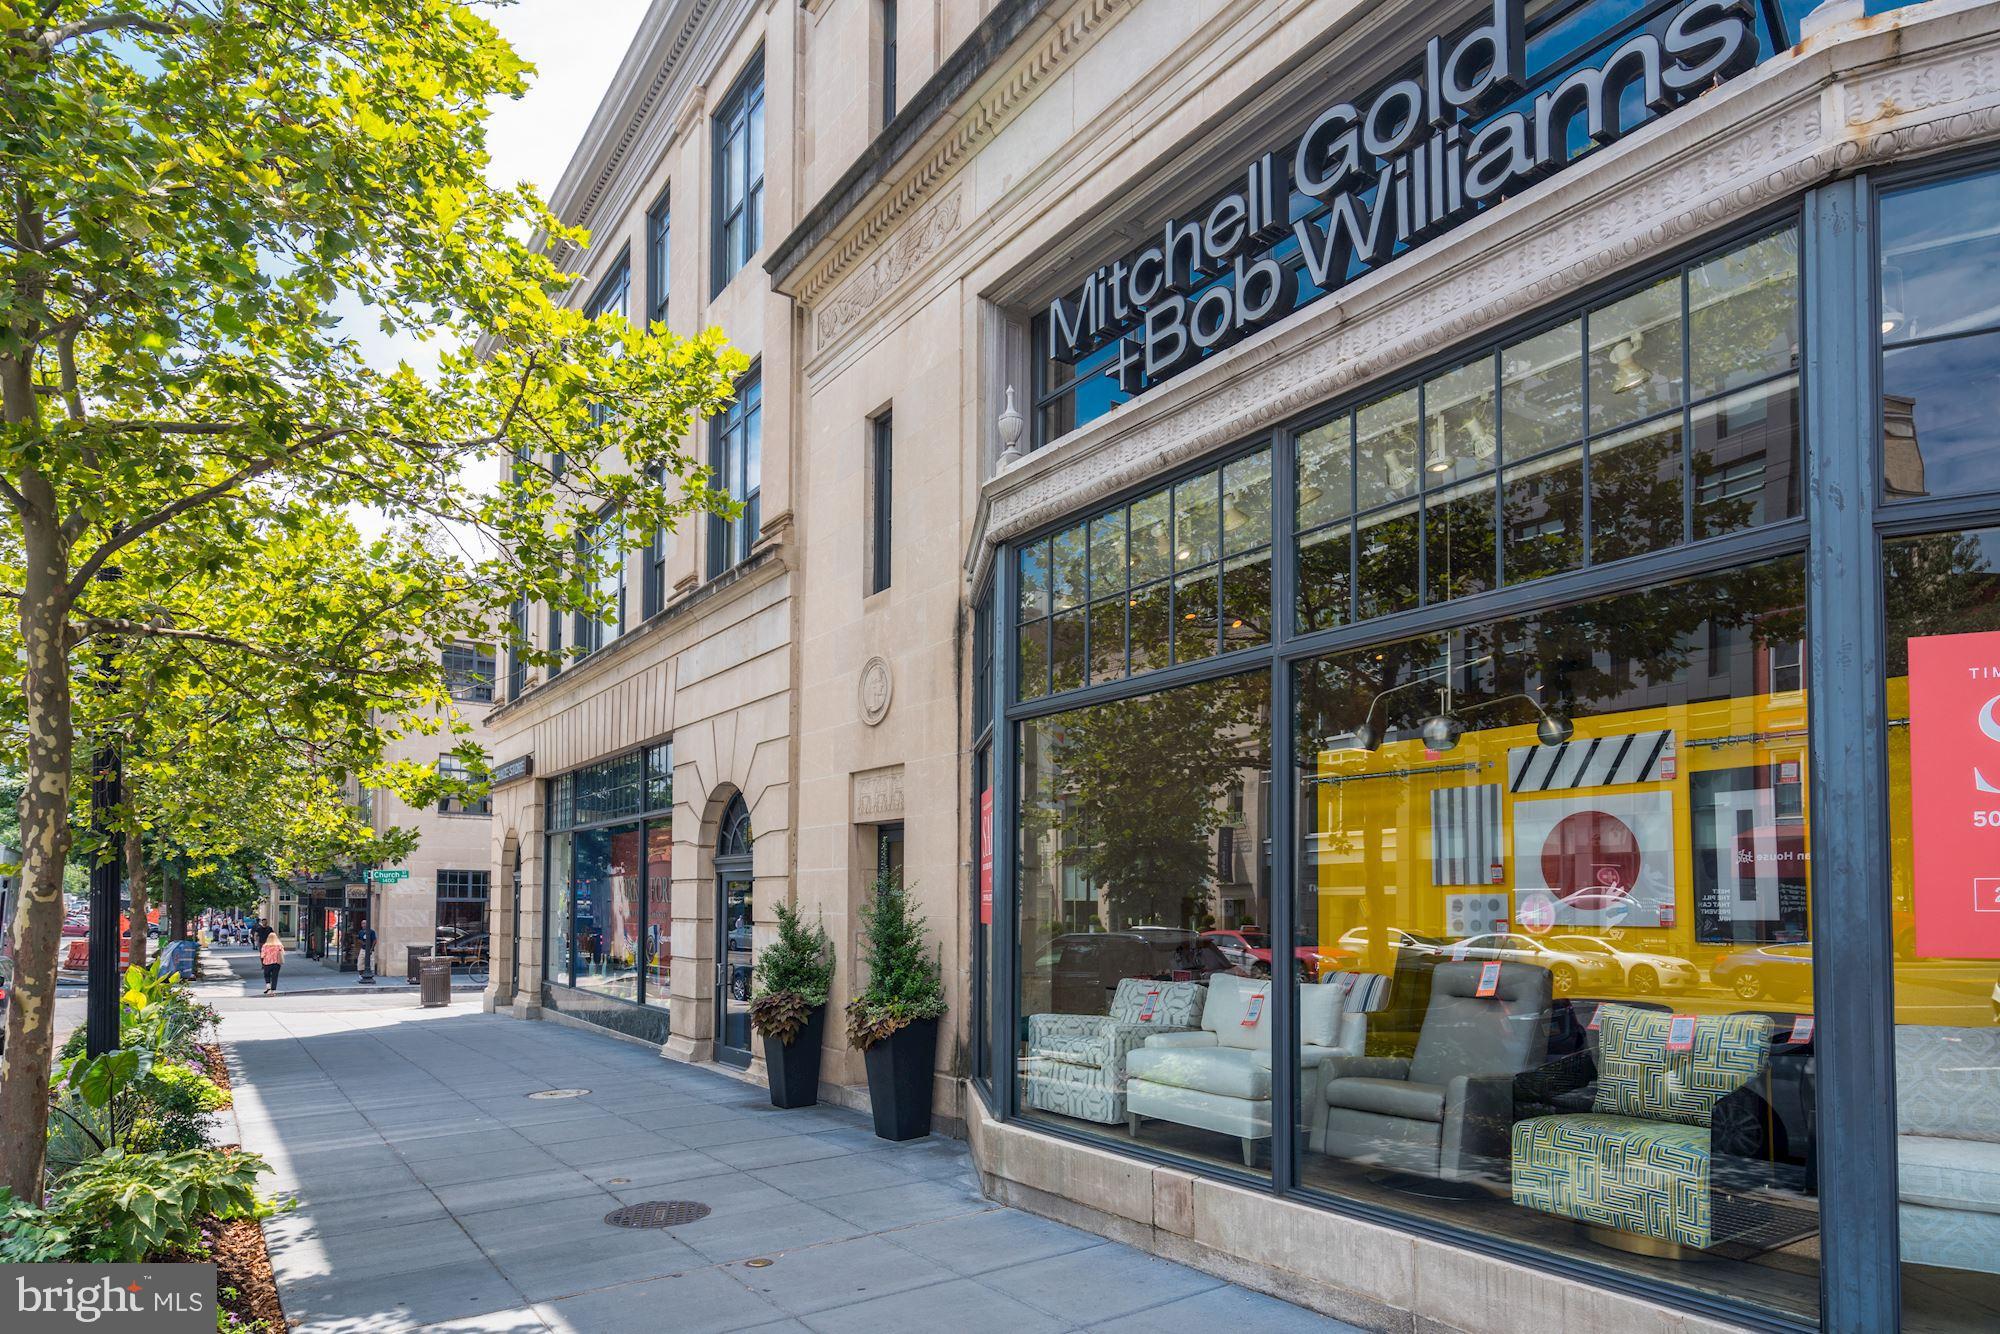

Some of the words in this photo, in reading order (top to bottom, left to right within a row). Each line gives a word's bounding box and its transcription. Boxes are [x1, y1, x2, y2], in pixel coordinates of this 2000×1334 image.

[1050, 152, 1277, 360] Mitchell
[1294, 0, 1510, 197] Gold
[1105, 254, 1283, 391] +Bob
[1293, 0, 1748, 288] Williams
[373, 871, 400, 879] Church
